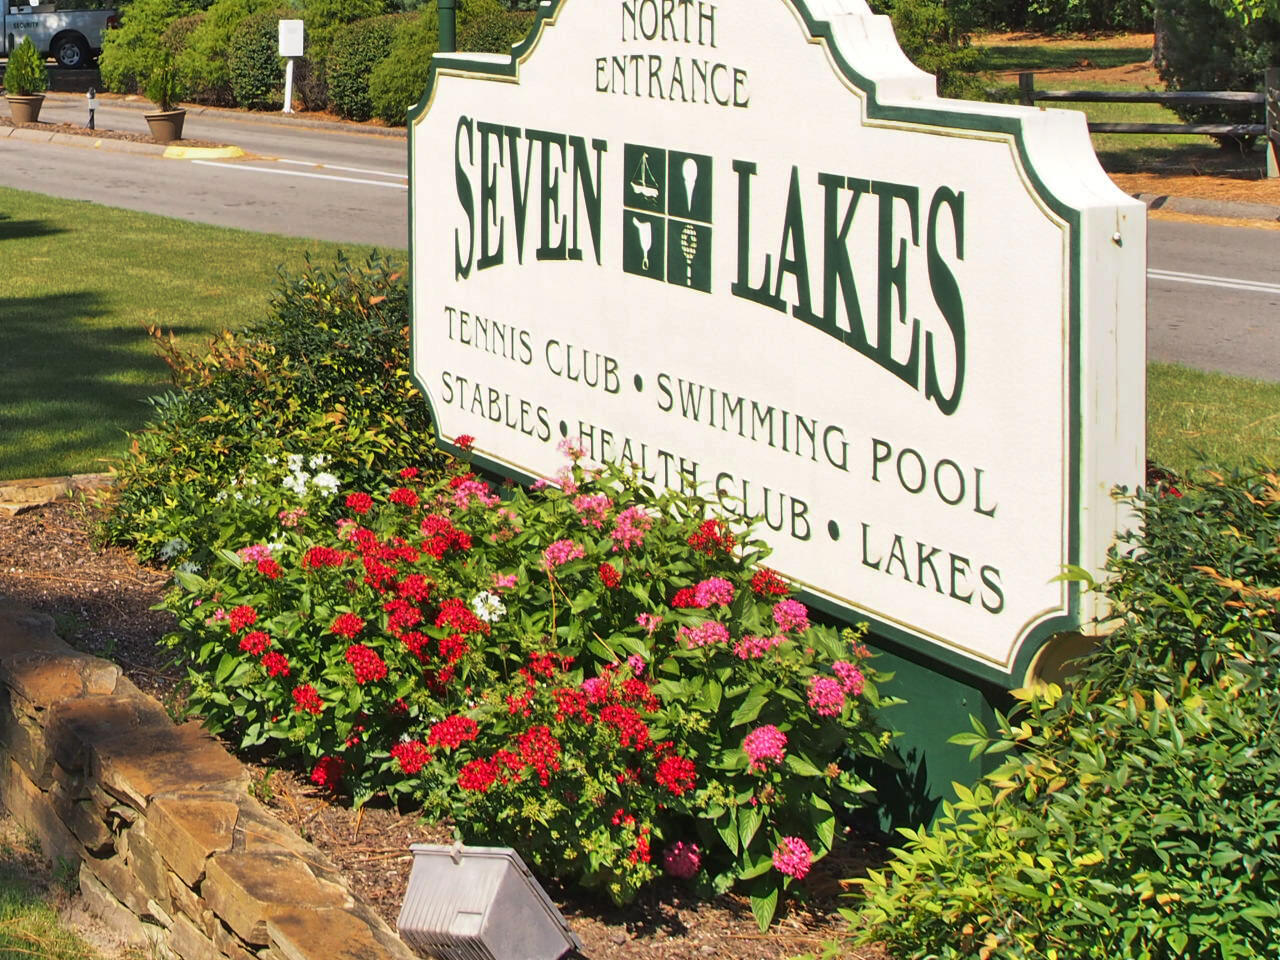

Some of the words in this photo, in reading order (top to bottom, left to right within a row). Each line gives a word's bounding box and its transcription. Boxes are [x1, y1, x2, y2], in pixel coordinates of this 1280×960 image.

[595, 54, 750, 108] ENTRANCE
[455, 115, 608, 282] SEVEN
[731, 159, 966, 417] LAKES
[441, 370, 552, 442] STABLES
[578, 420, 701, 497] HEALTH
[715, 471, 812, 541] CLUB
[861, 522, 1005, 614] LAKES
[444, 305, 533, 366] TENNIS
[545, 339, 621, 394] CLUB
[656, 373, 851, 473] SWIMMING
[871, 437, 998, 518] POOL
